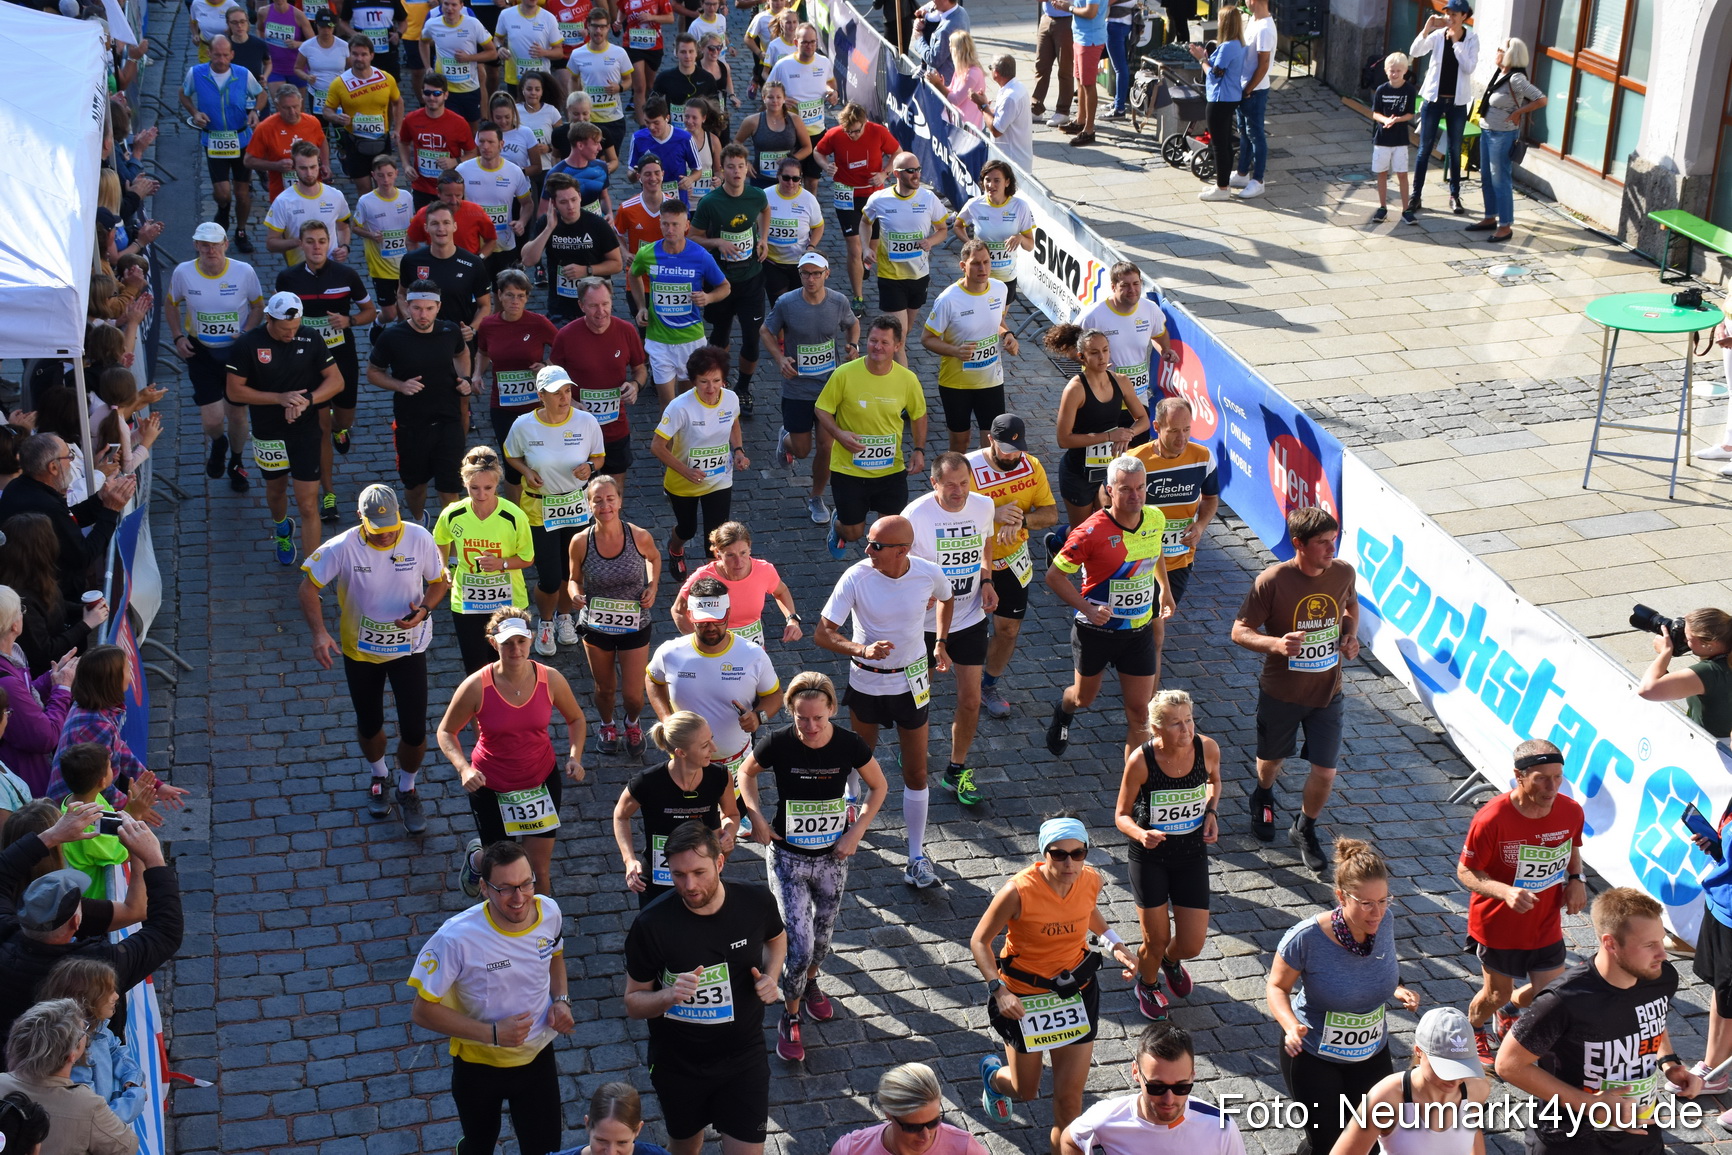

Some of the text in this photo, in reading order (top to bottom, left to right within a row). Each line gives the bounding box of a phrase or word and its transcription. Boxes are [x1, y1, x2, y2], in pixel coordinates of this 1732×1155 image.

[268, 31, 291, 41] 2118
[372, 37, 387, 46] 119
[633, 35, 654, 44] 2261
[446, 66, 467, 75] 2318
[351, 90, 369, 100] MAX
[591, 93, 614, 103] 1272
[802, 104, 822, 119] 2497
[357, 122, 382, 133] 2406
[212, 139, 237, 151] 1056
[420, 159, 440, 169] 211
[770, 220, 797, 228] BOCK
[553, 234, 582, 244] Reebok
[769, 227, 795, 239] 2392
[891, 231, 922, 239] BOCK
[384, 239, 405, 249] 262
[892, 241, 920, 252] 2804
[990, 250, 1008, 261] 414
[1034, 227, 1080, 296] swn
[659, 265, 695, 278] Freitag
[655, 283, 690, 292] BOCK
[657, 294, 689, 305] 2132
[200, 313, 235, 323] BOCK
[202, 322, 236, 334] 2824
[975, 334, 998, 348] OCK
[801, 342, 832, 355] BOCK
[971, 346, 996, 361] 2780
[803, 351, 832, 366] 2099
[972, 358, 995, 367] THOMAS
[1119, 365, 1148, 375] BOCK
[501, 372, 534, 381] BOCK
[1131, 375, 1147, 388] 588
[503, 382, 536, 397] 2270
[584, 390, 617, 400] BOCK
[586, 401, 618, 414] 2271
[1223, 396, 1247, 420] STORE
[859, 436, 894, 446] BOCK
[1230, 421, 1252, 449] ONLINE
[695, 446, 727, 457] BOCK
[858, 446, 892, 459] 2206
[693, 457, 724, 469] 2154
[1230, 448, 1252, 477] MOBILE
[1010, 479, 1039, 495] BÖGL
[1154, 483, 1196, 495] Fischer
[548, 492, 583, 506] BOCK
[1158, 491, 1193, 499] AUTOMOBILE
[549, 503, 584, 519] 2046
[552, 517, 582, 526] KERSTIN
[463, 538, 502, 548] Müller
[941, 537, 980, 550] BOCK
[1162, 545, 1185, 554] EPHAN
[941, 551, 979, 566] 2589
[1015, 556, 1029, 572] 12
[945, 567, 975, 575] ALBERT
[466, 576, 505, 585] BOCK
[1114, 578, 1152, 591] BOCK
[468, 588, 507, 601] 2334
[1114, 590, 1150, 607] 2692
[473, 602, 503, 610] MONIKA
[596, 600, 636, 612] BOCK
[364, 619, 401, 630] BOC
[595, 612, 635, 627] 2329
[1297, 618, 1335, 630] BANANA JOE
[364, 631, 407, 645] 2225
[1298, 642, 1335, 660] 2003
[722, 663, 733, 671] 20
[1294, 658, 1335, 668] SEBASTIAN
[504, 789, 543, 804] BOCK
[1156, 789, 1202, 804] BOCK
[507, 801, 546, 820] 1337
[793, 802, 840, 814] BOCK
[1157, 803, 1202, 822] 2645
[519, 821, 545, 831] HEIKE
[793, 815, 841, 833] 2027
[1163, 820, 1196, 831] GISELA
[794, 833, 837, 845] ISABELLE
[1526, 845, 1570, 861] BOCK
[1523, 858, 1566, 878] 2500
[1522, 875, 1561, 888] NORBERT
[1047, 924, 1077, 937] OEXL
[487, 959, 511, 970] BOCK
[665, 967, 722, 984] BCK
[684, 987, 724, 1006] 53
[678, 1008, 717, 1018] JULIAN
[1635, 995, 1668, 1024] ROTH
[1028, 1008, 1080, 1033] 1253
[1332, 1011, 1382, 1028] BOCK
[1034, 1029, 1082, 1045] KRISTINA
[1330, 1027, 1380, 1047] 2004
[1327, 1043, 1378, 1058] FRANZISKA
[1584, 1033, 1640, 1075] FINI
